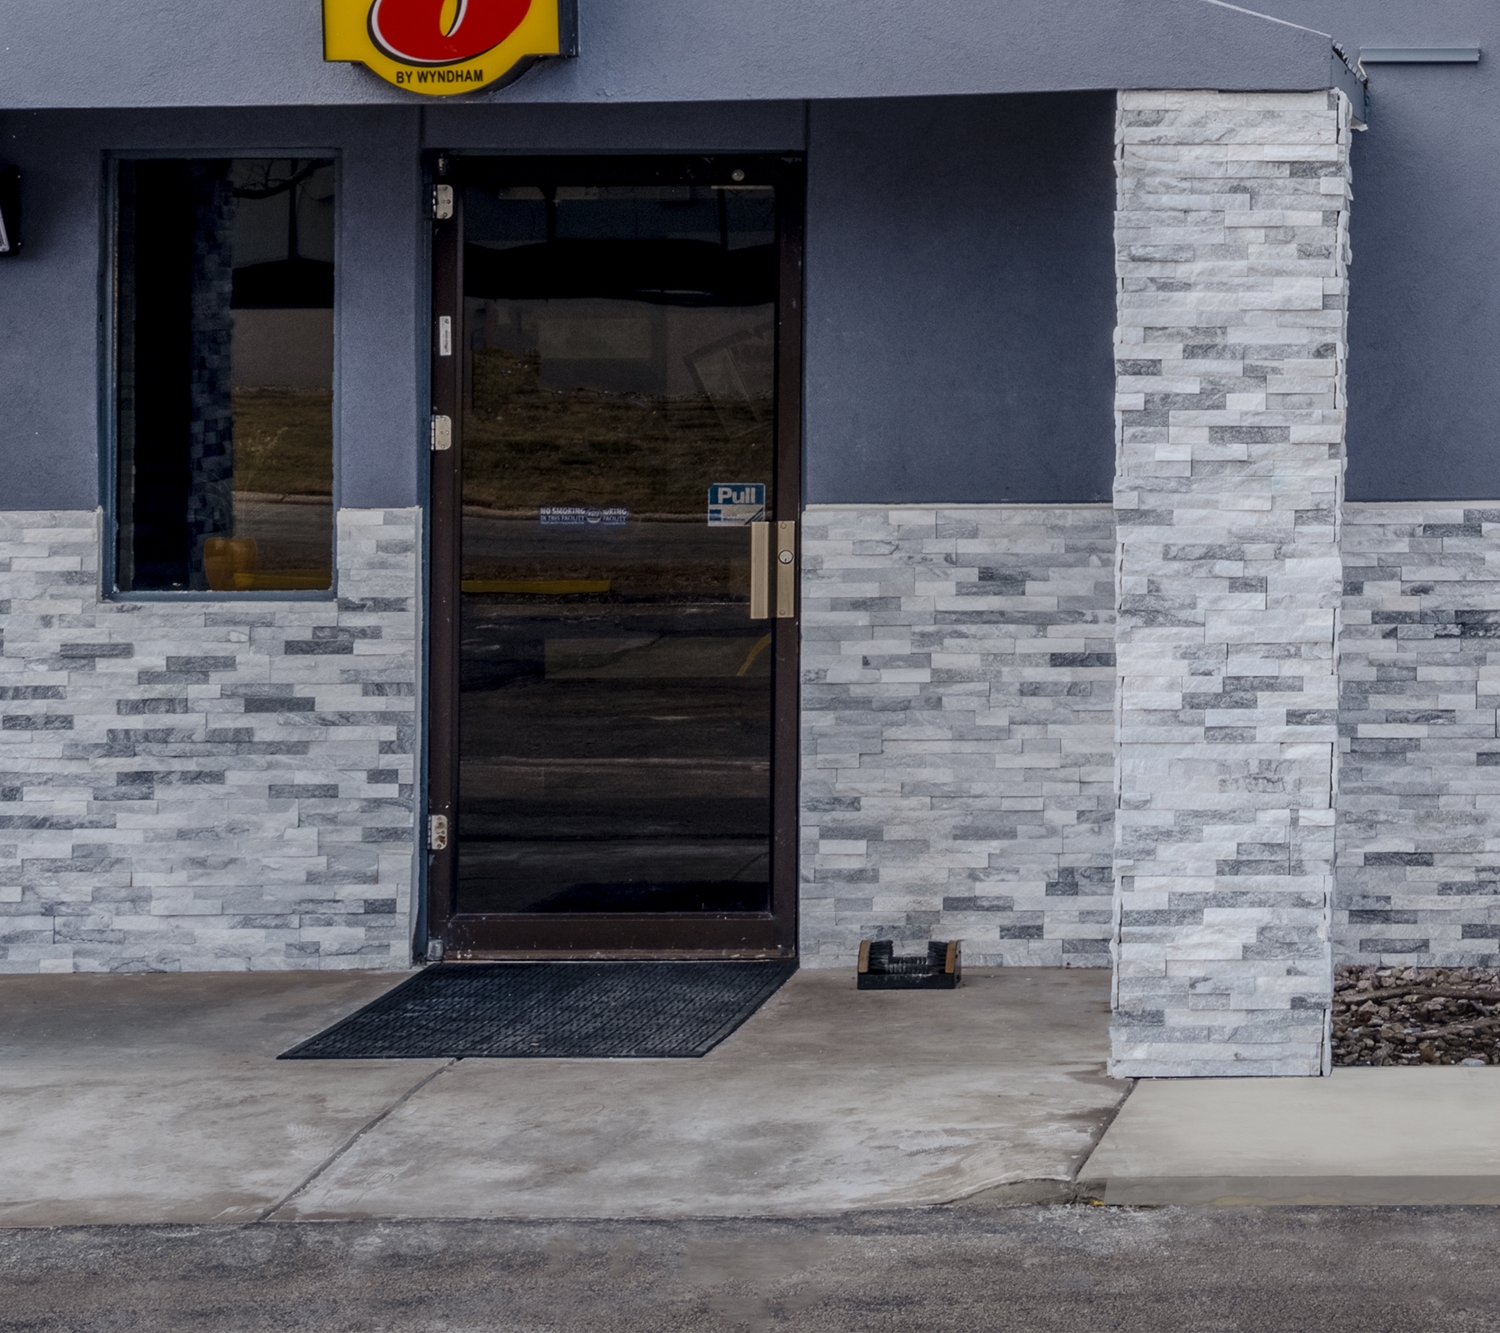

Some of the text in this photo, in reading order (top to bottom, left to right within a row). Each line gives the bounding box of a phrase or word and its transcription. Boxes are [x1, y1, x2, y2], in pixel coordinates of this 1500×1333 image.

[396, 69, 483, 83] BY WYNDHAM
[717, 487, 756, 503] Pull
[540, 507, 551, 515] NO
[552, 507, 586, 515] SMOKING
